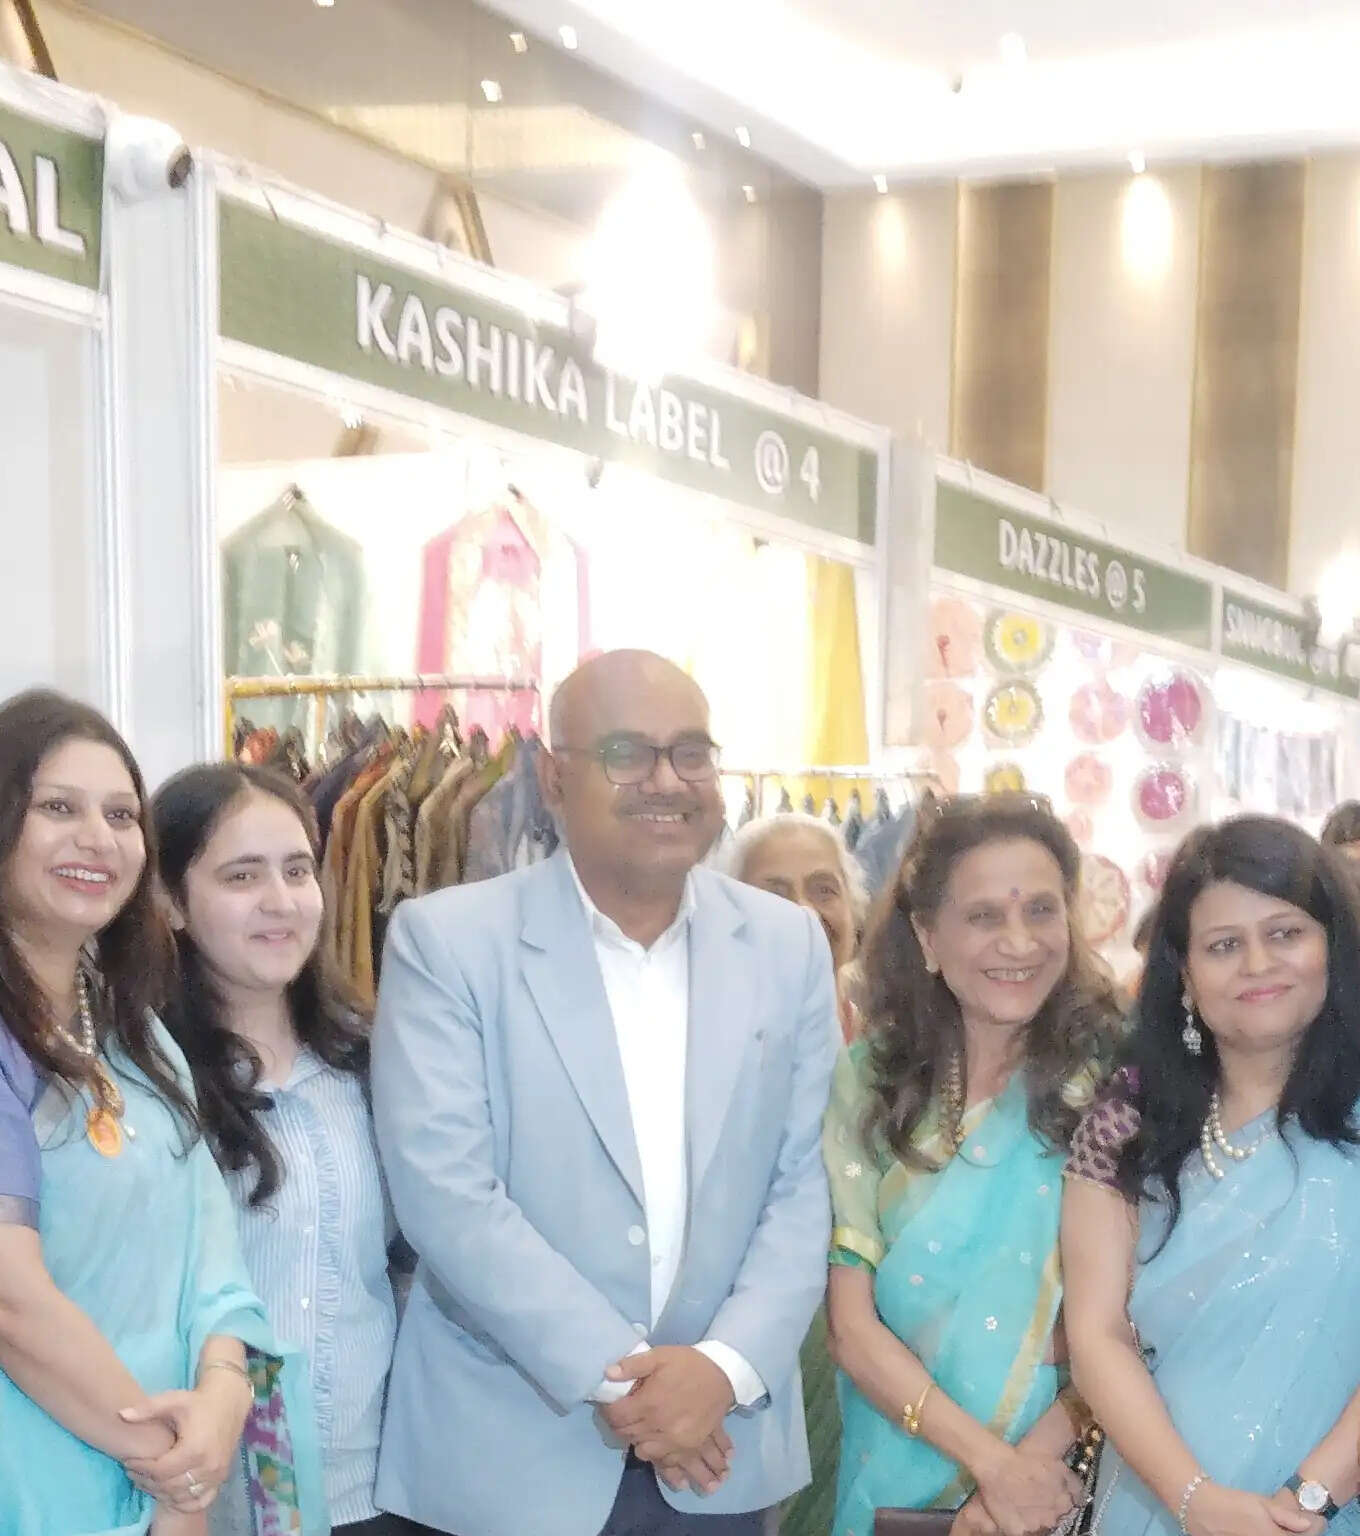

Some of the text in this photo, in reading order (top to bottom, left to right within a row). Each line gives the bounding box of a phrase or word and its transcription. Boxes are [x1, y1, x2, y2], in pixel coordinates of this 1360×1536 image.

[355, 274, 821, 504] KASHIKA LABEL @ 4
[999, 518, 1100, 600] DAZZLES
